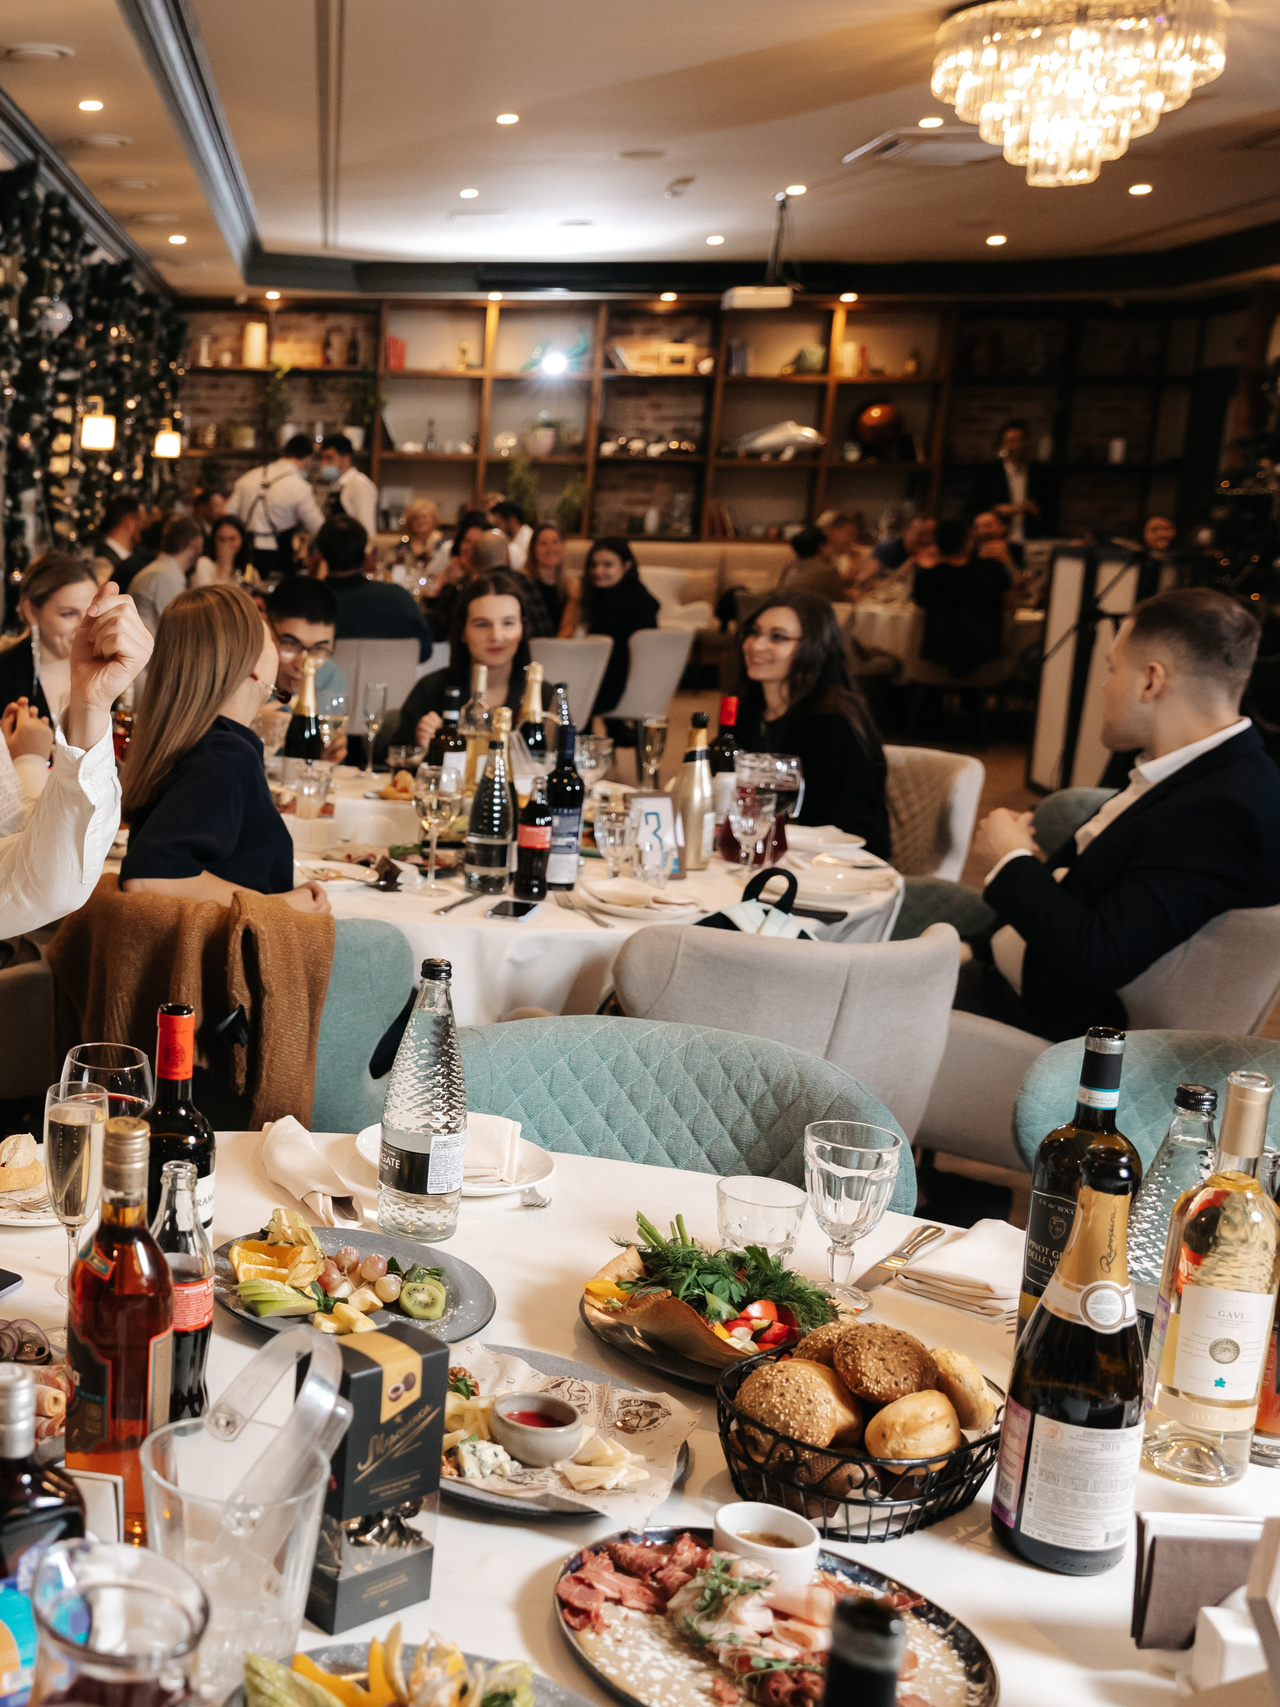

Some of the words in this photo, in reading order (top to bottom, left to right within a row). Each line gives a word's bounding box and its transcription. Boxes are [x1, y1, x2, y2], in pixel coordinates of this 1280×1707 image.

[1028, 1238, 1049, 1256] PINOT
[1028, 1248, 1047, 1265] DELLE
[1218, 1310, 1244, 1320] GAVI
[1099, 1443, 1121, 1452] 2016
